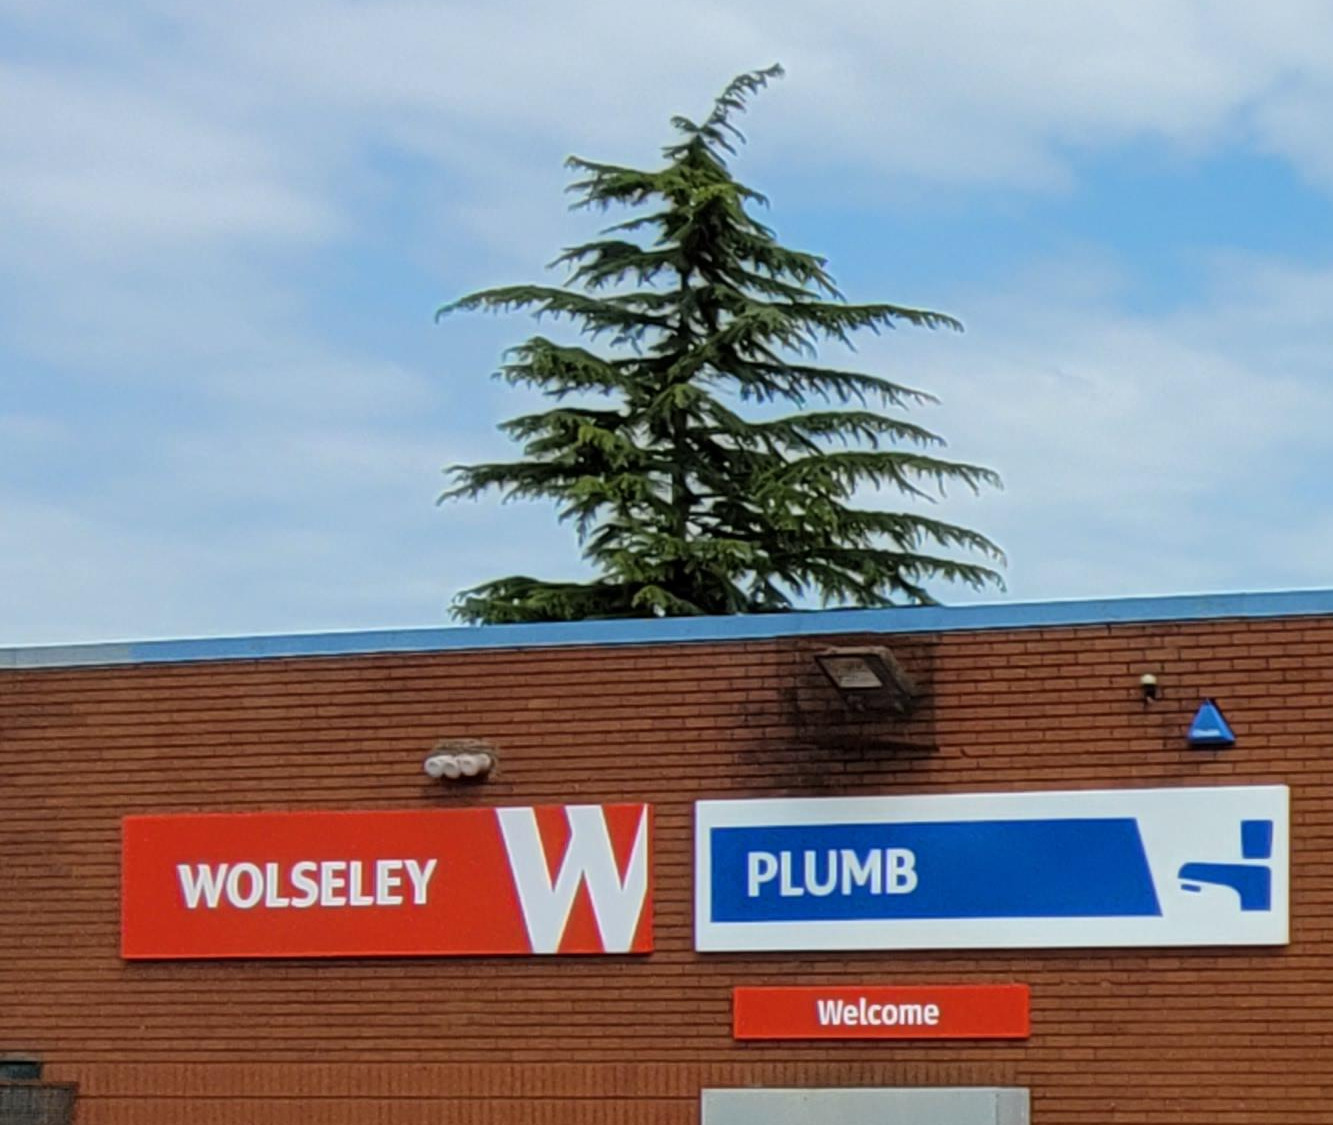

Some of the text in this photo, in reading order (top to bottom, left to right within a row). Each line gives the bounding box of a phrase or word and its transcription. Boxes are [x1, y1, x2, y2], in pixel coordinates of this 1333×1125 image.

[177, 858, 438, 909] WOLSELEY
[495, 804, 648, 953] W
[746, 848, 918, 897] PLUMB
[817, 997, 940, 1026] Welcome
